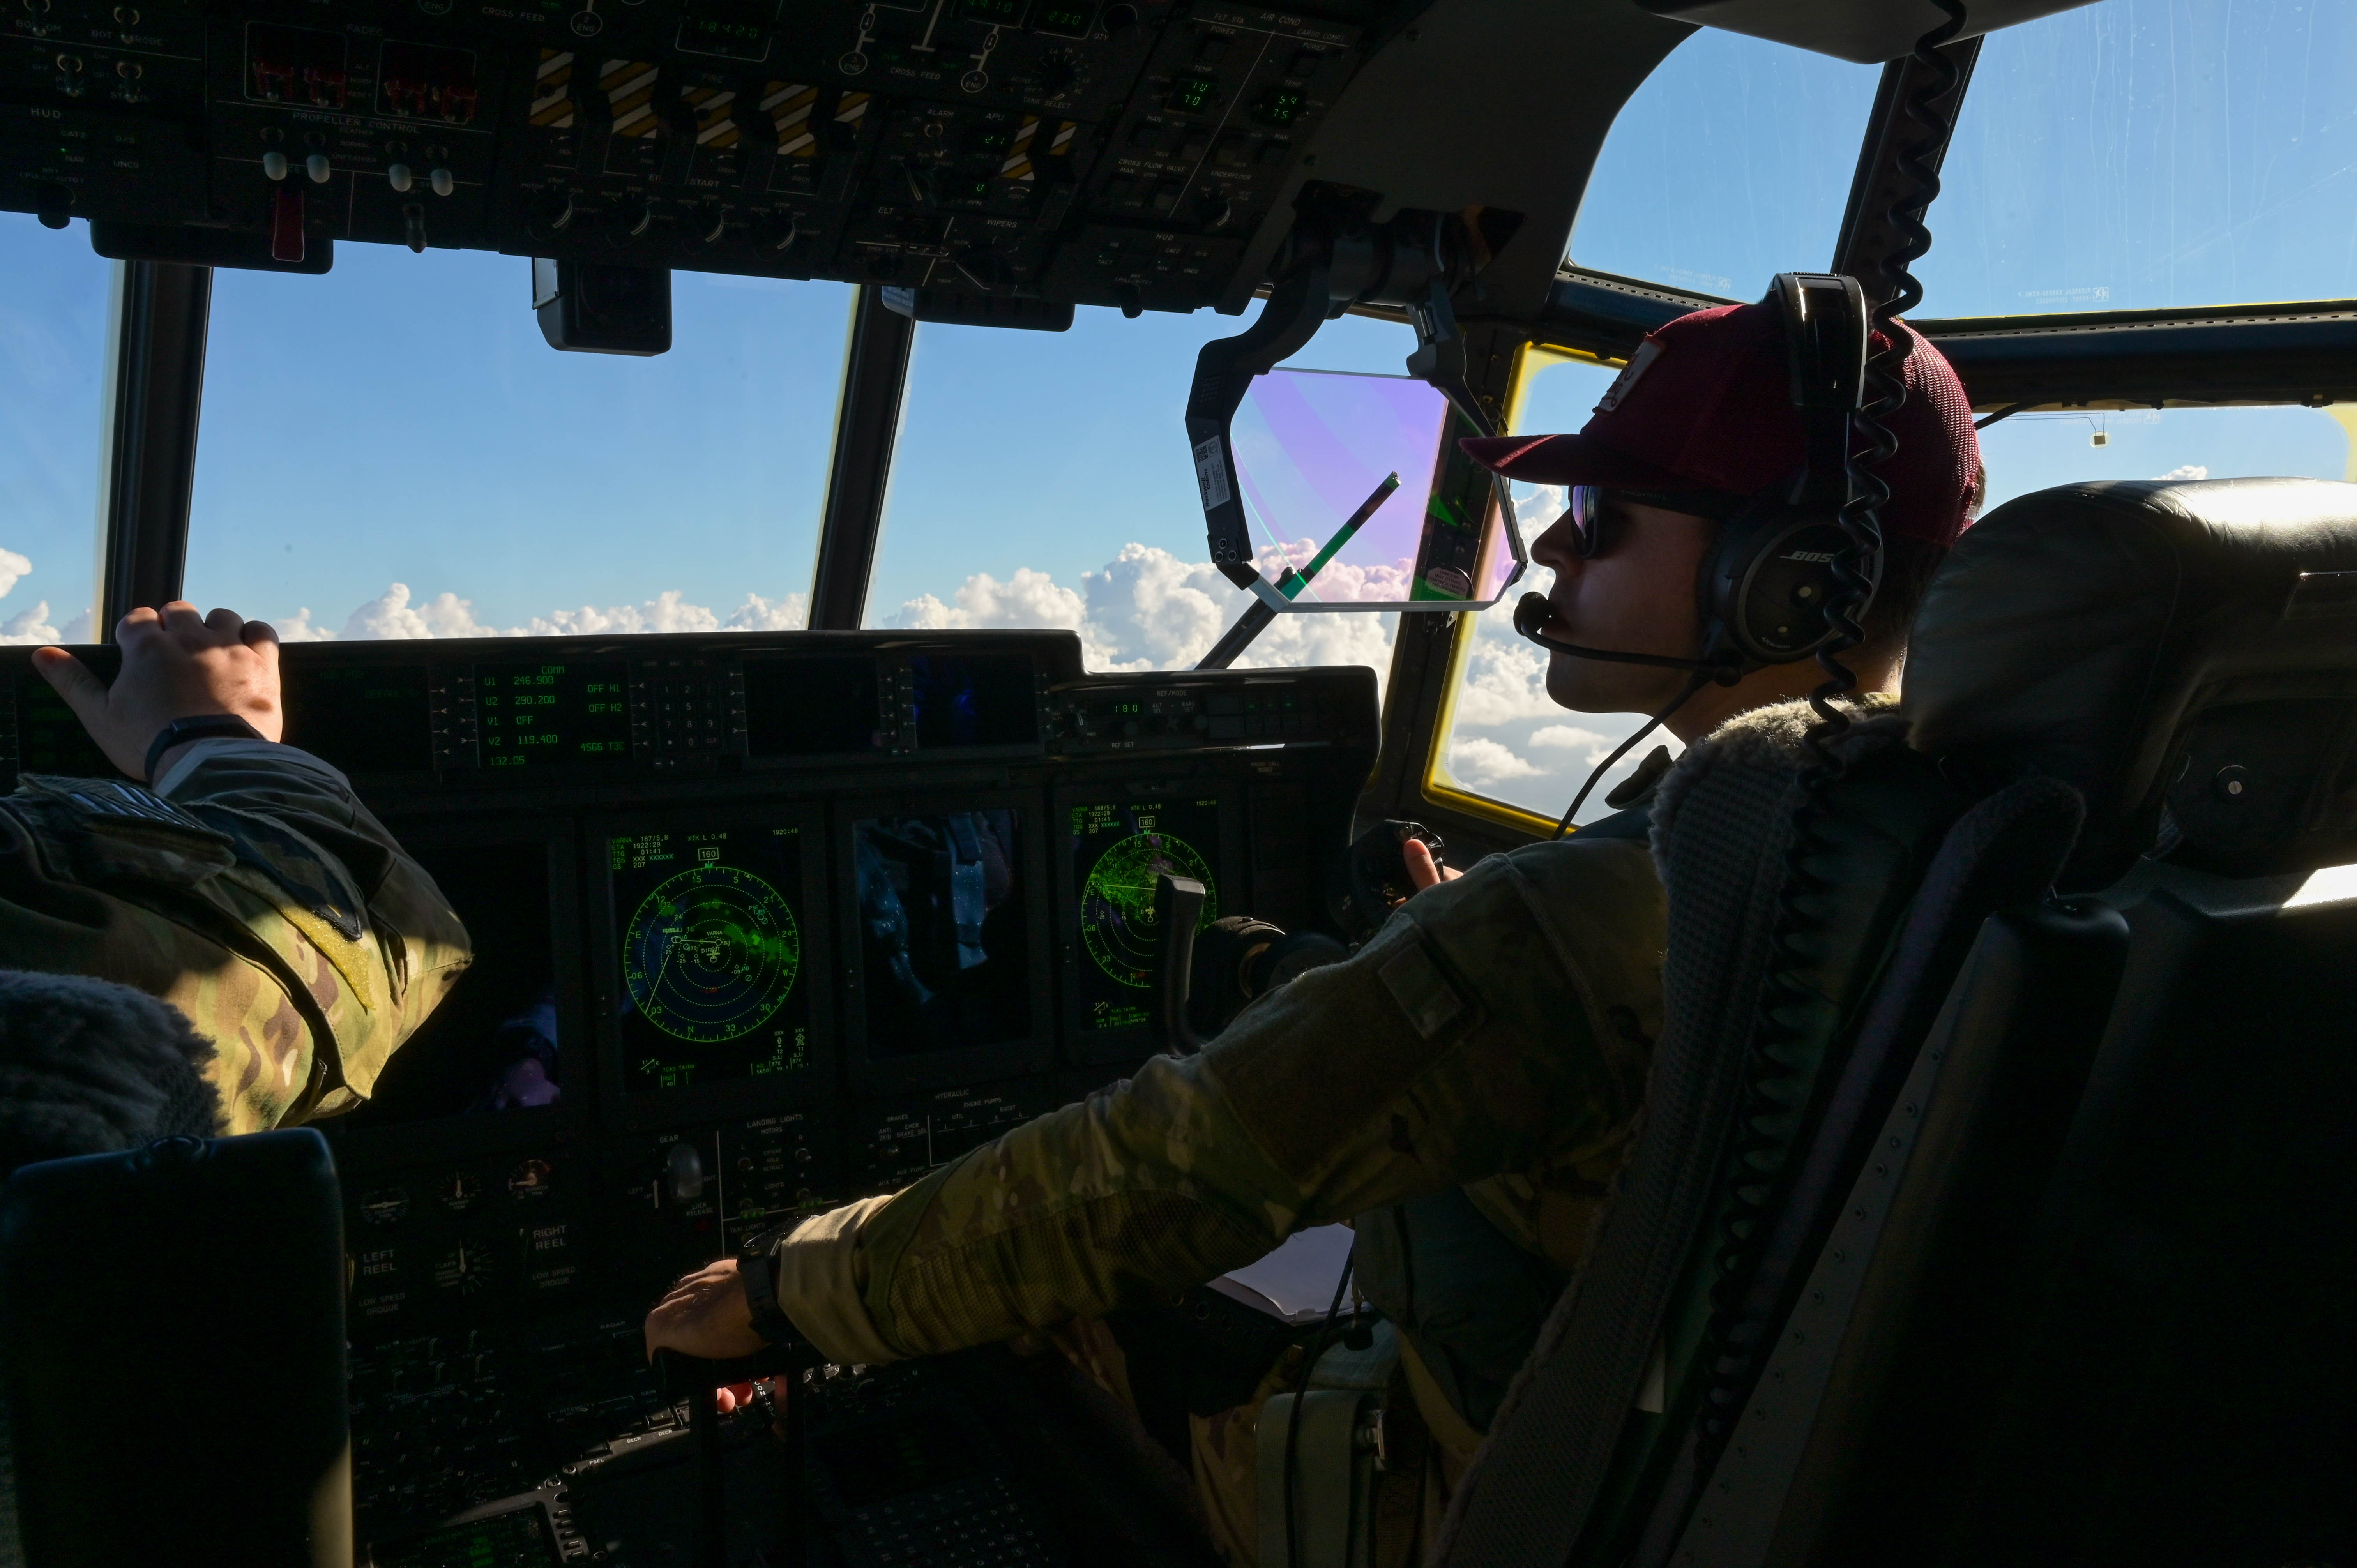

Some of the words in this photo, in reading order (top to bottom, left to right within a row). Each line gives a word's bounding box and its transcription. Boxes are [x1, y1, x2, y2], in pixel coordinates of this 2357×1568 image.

[482, 7, 514, 18] CROSS
[520, 12, 545, 22] FEED
[1049, 12, 1080, 25] 230
[1214, 12, 1227, 21] FLT
[1260, 12, 1275, 21] AIR
[1279, 16, 1301, 26] COND
[347, 24, 383, 37] FADEC
[577, 24, 595, 32] ENG
[700, 21, 758, 38] 18420
[1210, 26, 1236, 35] POWER
[1297, 28, 1319, 38] CARGO
[1302, 42, 1326, 51] POWER
[890, 67, 915, 76] CROSS
[920, 71, 940, 80] FEED
[1044, 101, 1071, 109] SELECT
[1185, 95, 1201, 106] 70
[31, 108, 61, 118] HUD
[985, 113, 1004, 121] APU
[1274, 109, 1288, 119] 75
[293, 112, 360, 126] PROPELLER
[369, 121, 419, 134] CONTROL
[1118, 159, 1141, 167] CROSS
[1166, 164, 1186, 173] VALVE
[1211, 171, 1252, 180] UNDERFLOOR
[690, 179, 720, 188] START
[987, 220, 1017, 228] WIPERS
[1201, 475, 1210, 506] Rockwell
[1780, 551, 1835, 563] BOS
[542, 666, 564, 674] COMM
[484, 677, 496, 686] U1
[514, 676, 553, 685] 246.900
[588, 685, 604, 693] OFF
[610, 684, 620, 692] H1
[486, 697, 498, 706] U2
[515, 696, 555, 705] 290.200
[589, 704, 605, 712] OFF
[611, 703, 622, 712] H2
[487, 717, 498, 726] V1
[516, 716, 533, 724] OFF
[488, 737, 500, 745] V2
[518, 735, 557, 744] 119.400
[580, 743, 603, 752] 4566
[491, 756, 525, 766] 132.05
[935, 1089, 970, 1100] HYDRAULIC
[747, 1118, 776, 1128] LANDING
[780, 1114, 804, 1124] LIGHTS
[887, 1114, 908, 1122] BRAKES
[761, 1127, 783, 1135] MOTORS
[659, 1134, 679, 1144] GEAR
[686, 1208, 713, 1217] RELEASE
[746, 1222, 765, 1231] LIGHTS
[533, 1225, 567, 1239] RIGHT
[535, 1238, 567, 1251] REEL
[363, 1249, 395, 1263] LEFT
[363, 1263, 397, 1276] REEL
[435, 1261, 457, 1269] FLAPS
[532, 1270, 549, 1280] LOW
[552, 1266, 576, 1278] SPEED
[540, 1277, 570, 1289] DROGUE
[359, 1297, 378, 1307] LOW
[380, 1293, 406, 1303] SPEED
[366, 1303, 399, 1315] DROGUE
